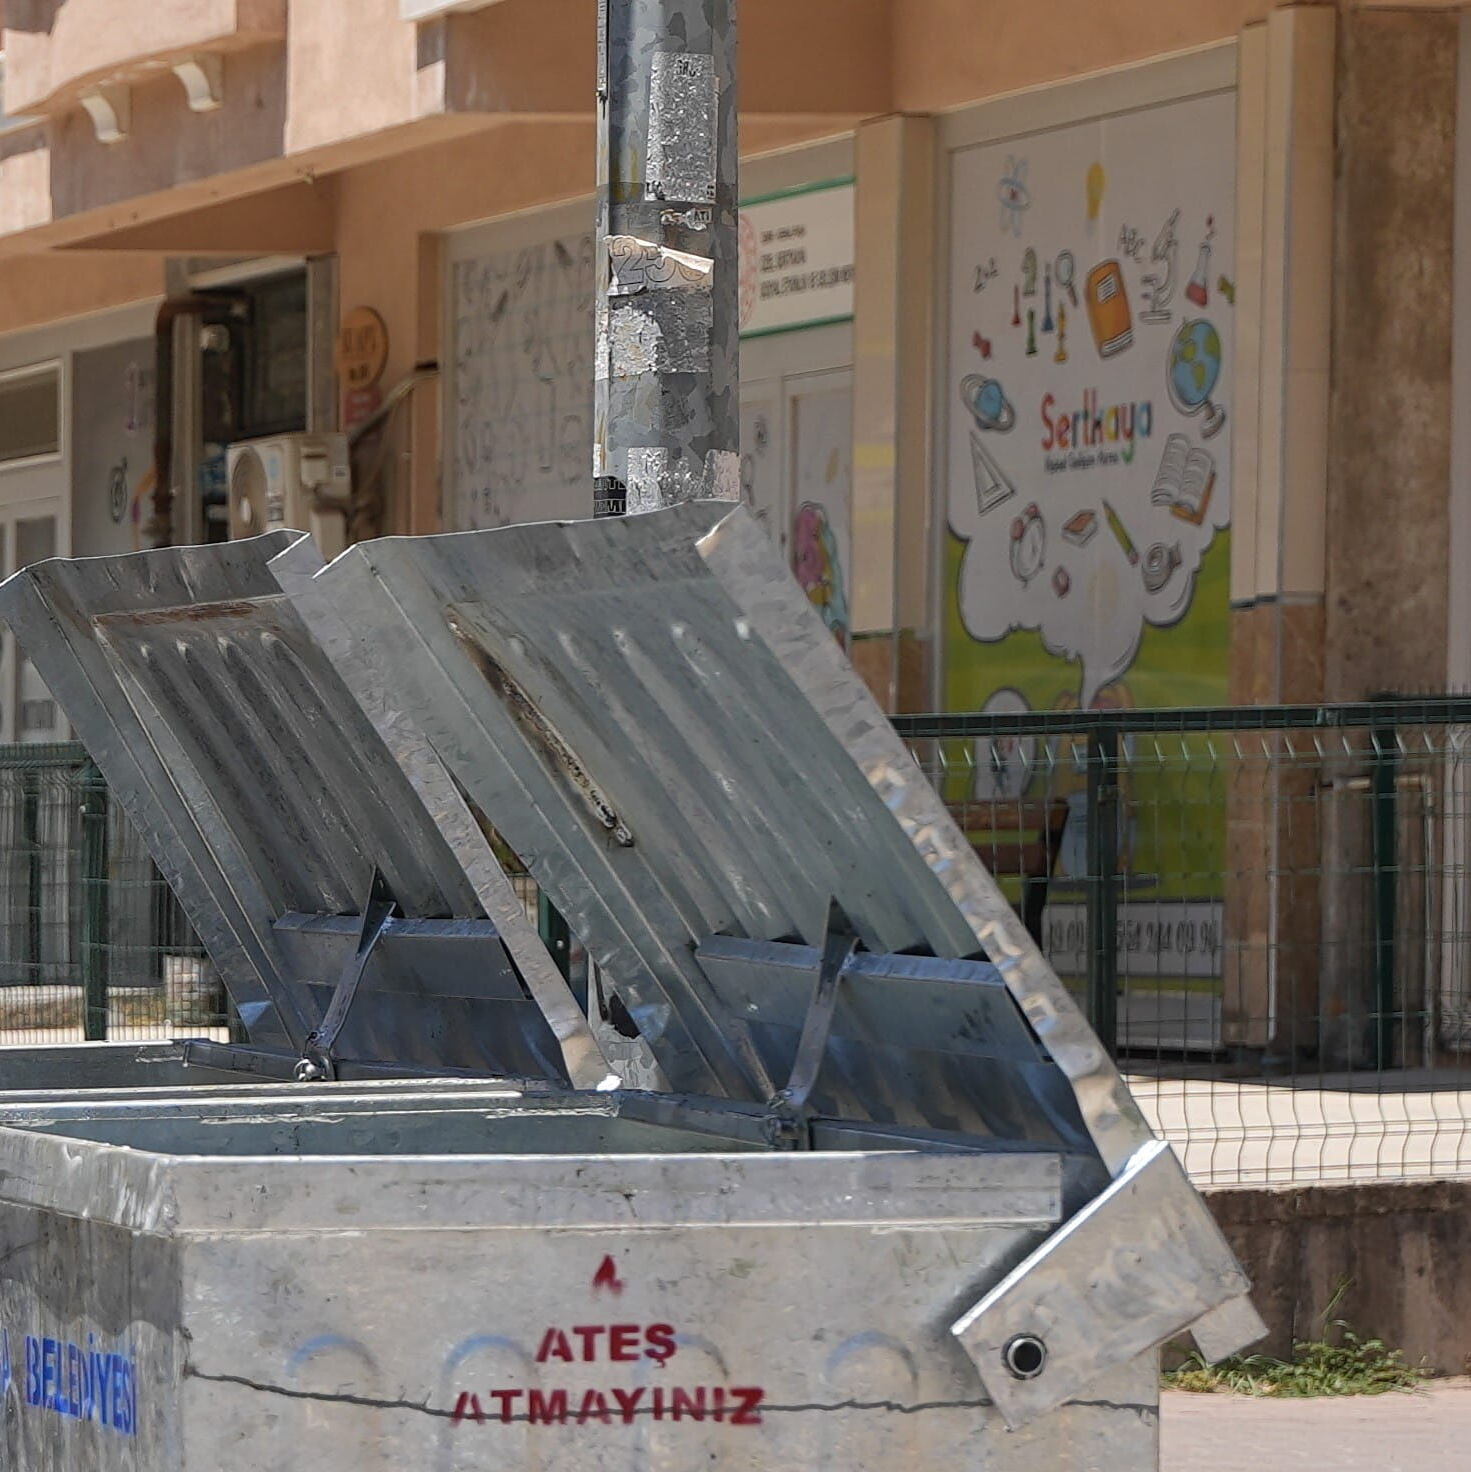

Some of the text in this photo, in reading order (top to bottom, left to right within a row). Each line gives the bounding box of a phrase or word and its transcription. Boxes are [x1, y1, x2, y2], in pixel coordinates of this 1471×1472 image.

[1041, 387, 1153, 466] Sertkaya
[535, 1322, 678, 1369] ATEŞ
[450, 1385, 766, 1427] ATMAYINIZ
